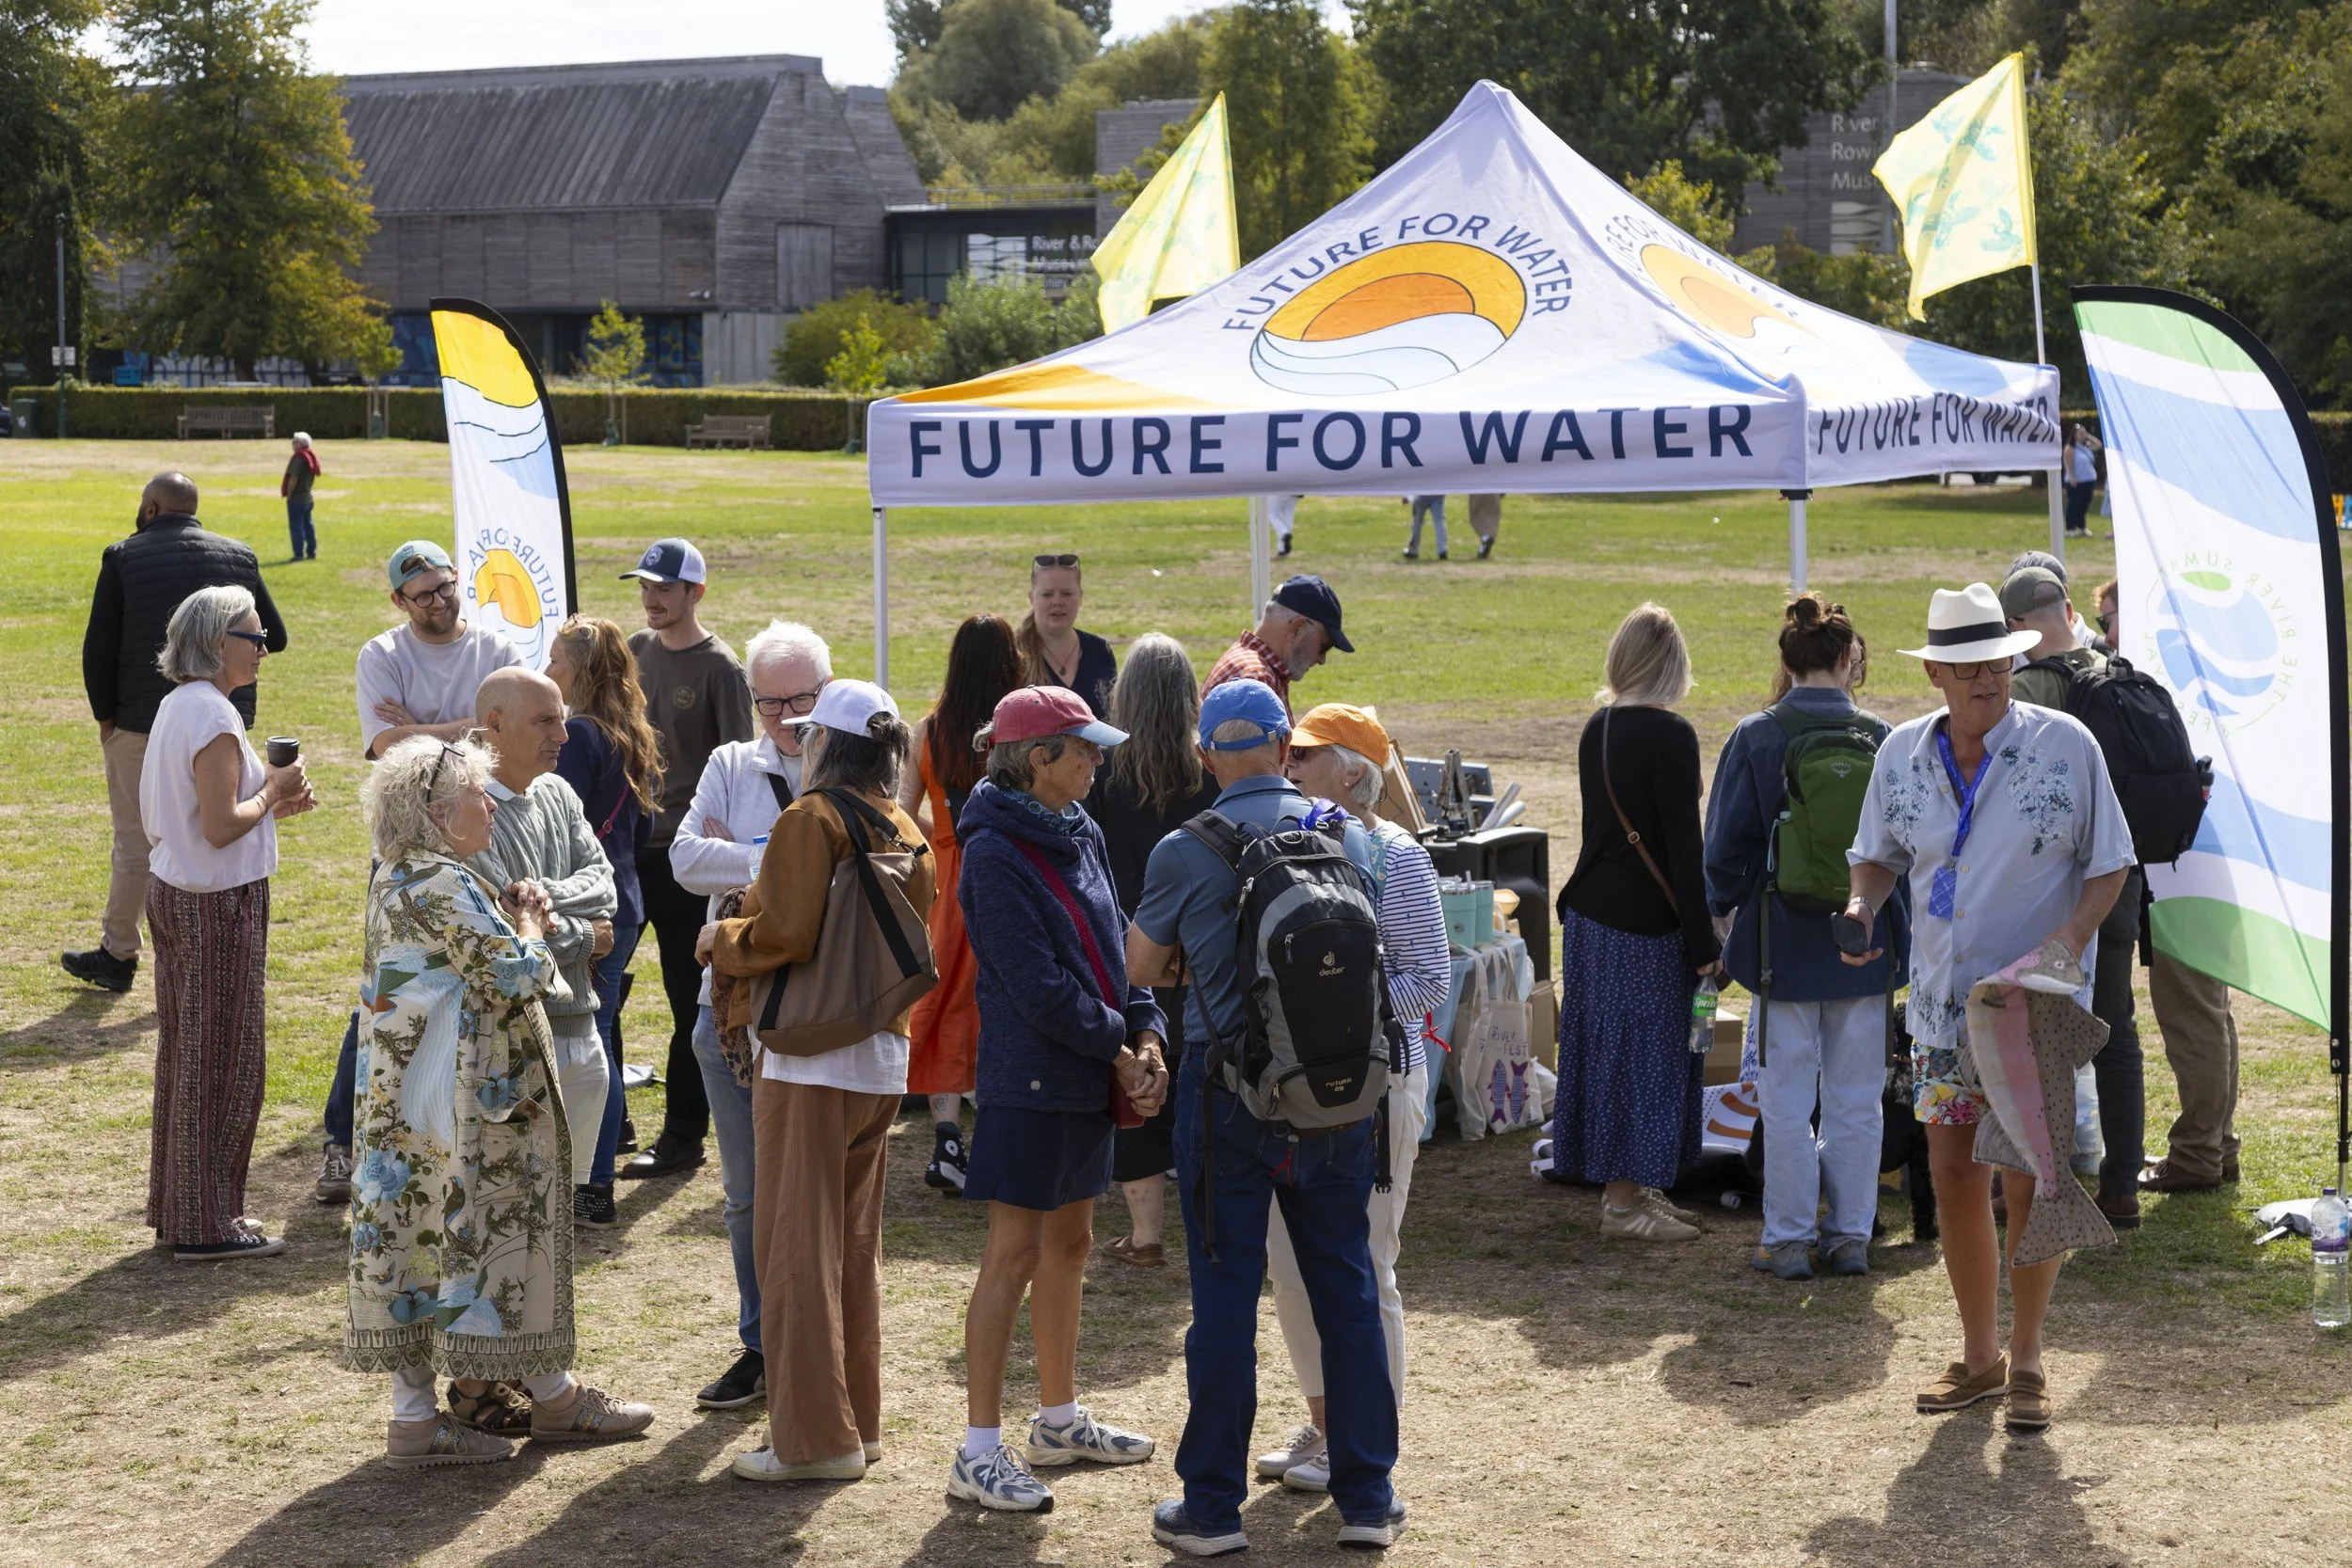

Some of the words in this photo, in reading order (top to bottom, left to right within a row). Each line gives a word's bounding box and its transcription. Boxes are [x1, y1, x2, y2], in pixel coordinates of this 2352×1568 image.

[1832, 114, 1879, 133] Rver
[1032, 235, 1066, 250] River
[1070, 234, 1081, 250] &
[1222, 226, 1383, 330] FUTURE
[1398, 213, 1491, 240] FOR
[1495, 225, 1573, 316] WATER
[909, 414, 1226, 478] FUTURE
[1265, 411, 1423, 472] FOR
[1458, 404, 1754, 465] WATER
[1818, 396, 1921, 454] FUTURE
[1931, 391, 1979, 444] FOR
[1982, 396, 2055, 444] WATER
[1319, 966, 1345, 976] deuter
